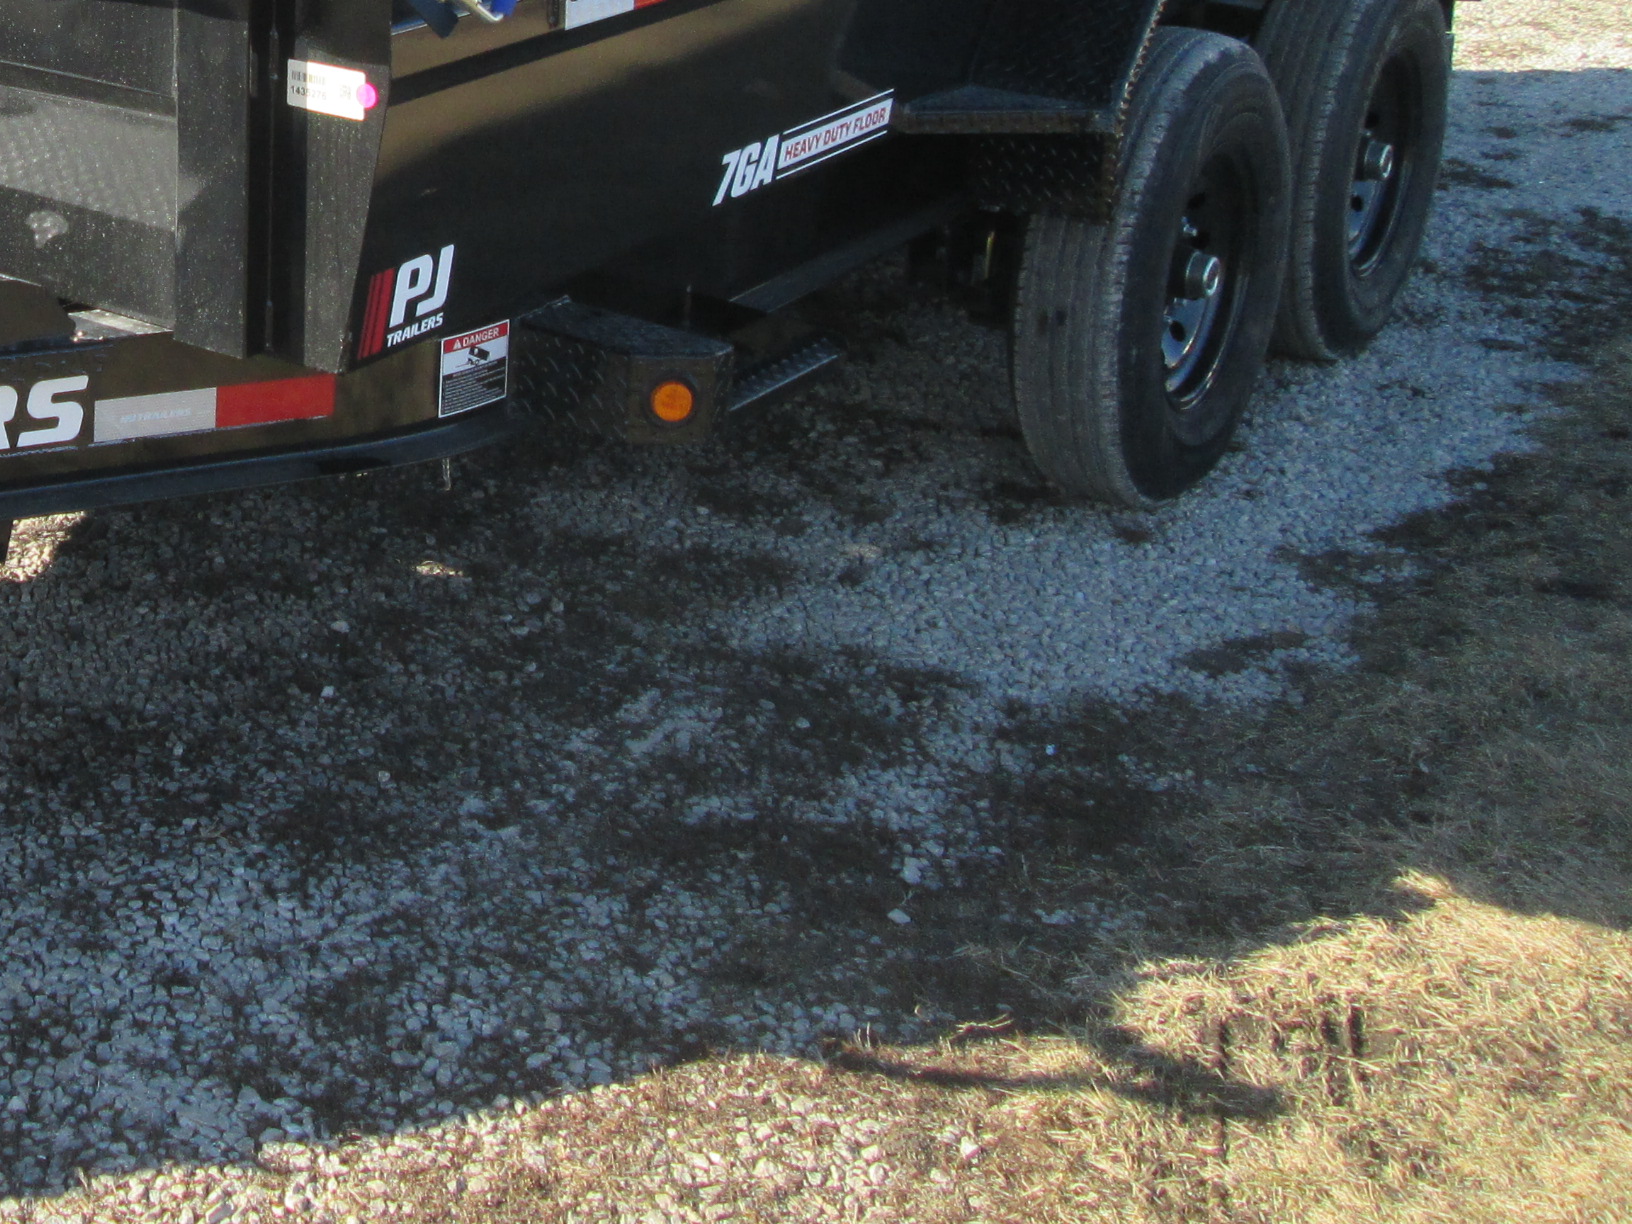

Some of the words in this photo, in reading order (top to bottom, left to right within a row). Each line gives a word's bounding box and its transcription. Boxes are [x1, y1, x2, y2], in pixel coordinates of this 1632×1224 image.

[712, 134, 780, 207] 7GA
[784, 132, 825, 162] HEAVY
[823, 121, 852, 145] DUTY
[853, 107, 887, 132] FLOOR
[389, 244, 455, 328] PJ
[386, 313, 444, 348] TRAILERS
[463, 327, 500, 347] DANGER
